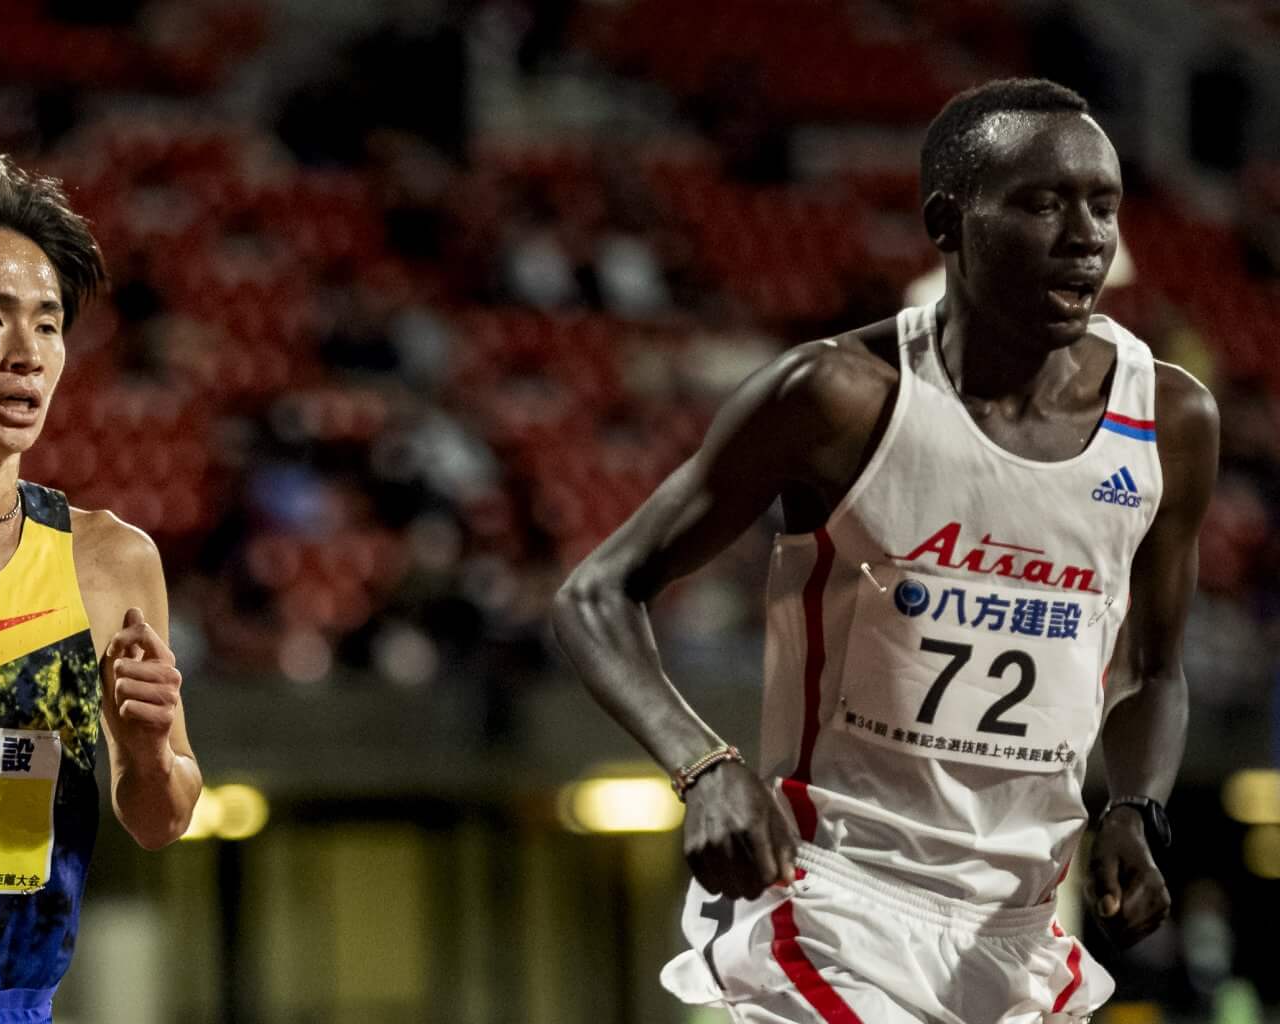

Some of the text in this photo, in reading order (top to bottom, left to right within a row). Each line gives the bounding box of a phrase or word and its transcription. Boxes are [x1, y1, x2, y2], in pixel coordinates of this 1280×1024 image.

[1091, 488, 1141, 508] adidas
[885, 522, 1102, 594] Aisan
[931, 587, 1081, 640] 八方建設
[916, 637, 1037, 737] 72
